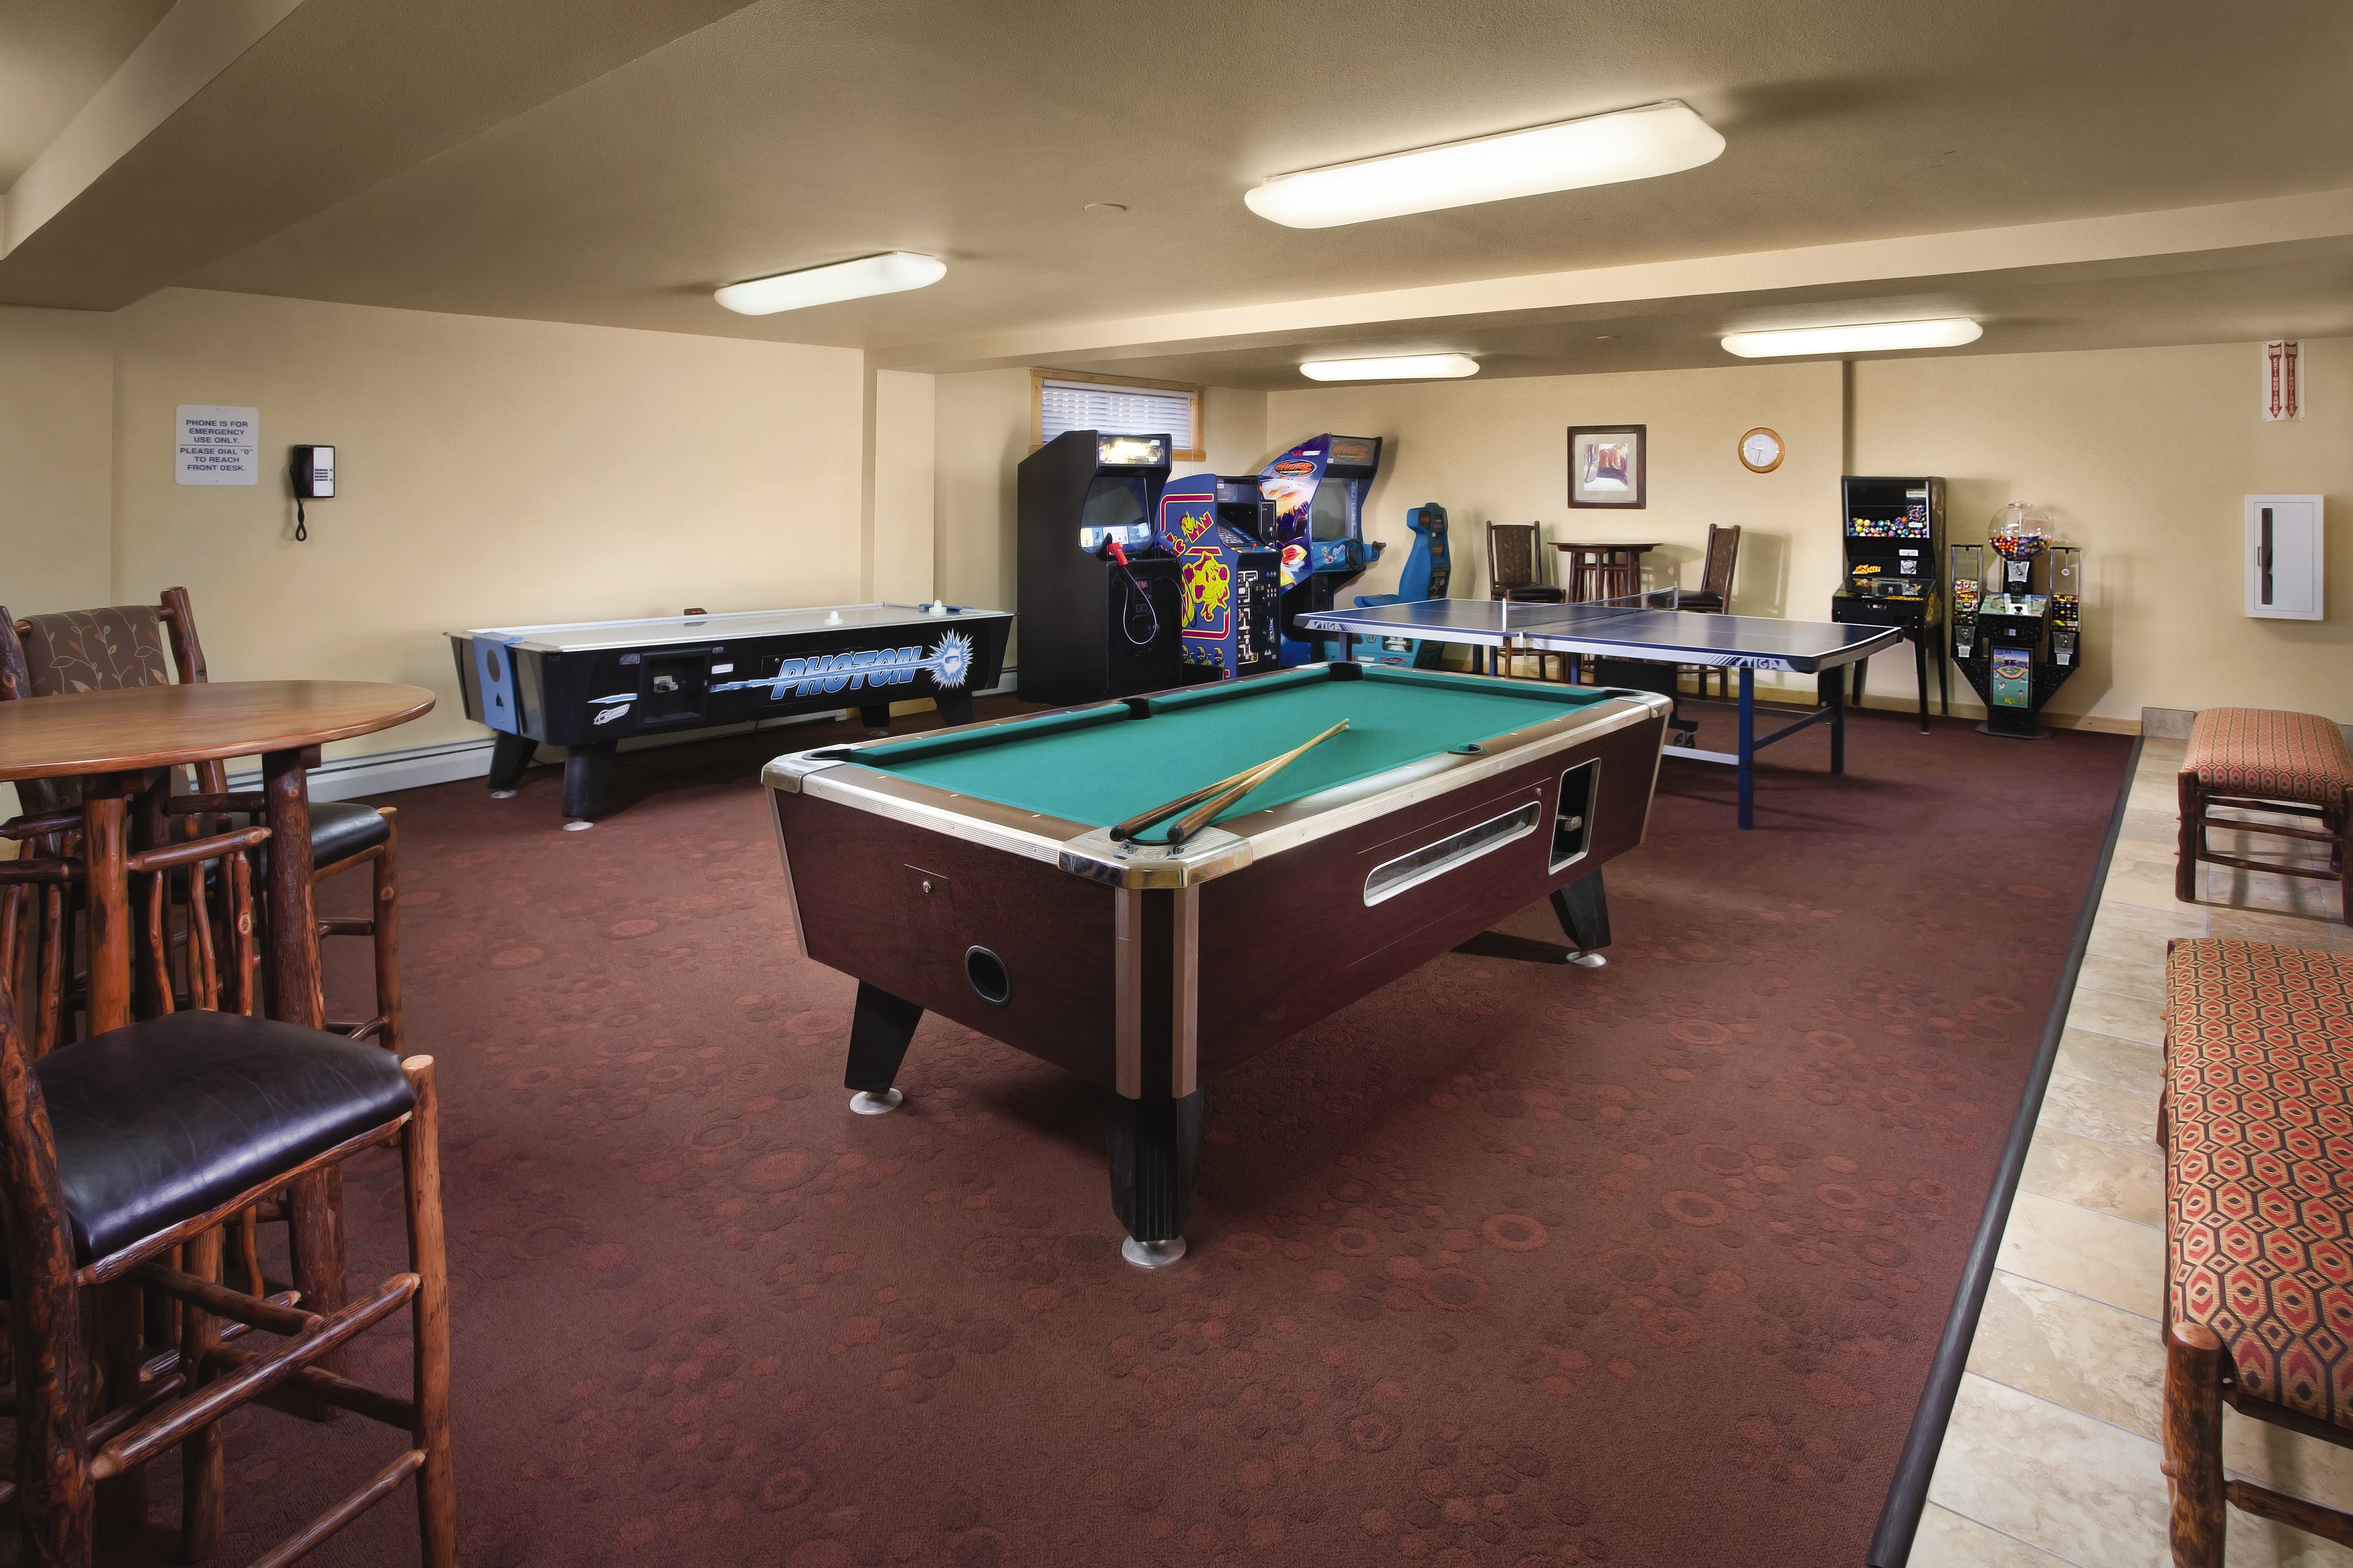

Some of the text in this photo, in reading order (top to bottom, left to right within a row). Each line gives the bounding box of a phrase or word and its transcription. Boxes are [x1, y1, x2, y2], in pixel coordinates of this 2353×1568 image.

[2269, 347, 2281, 356] FIRE
[1735, 657, 1780, 670] STIGA
[771, 646, 923, 700] PHOTON
